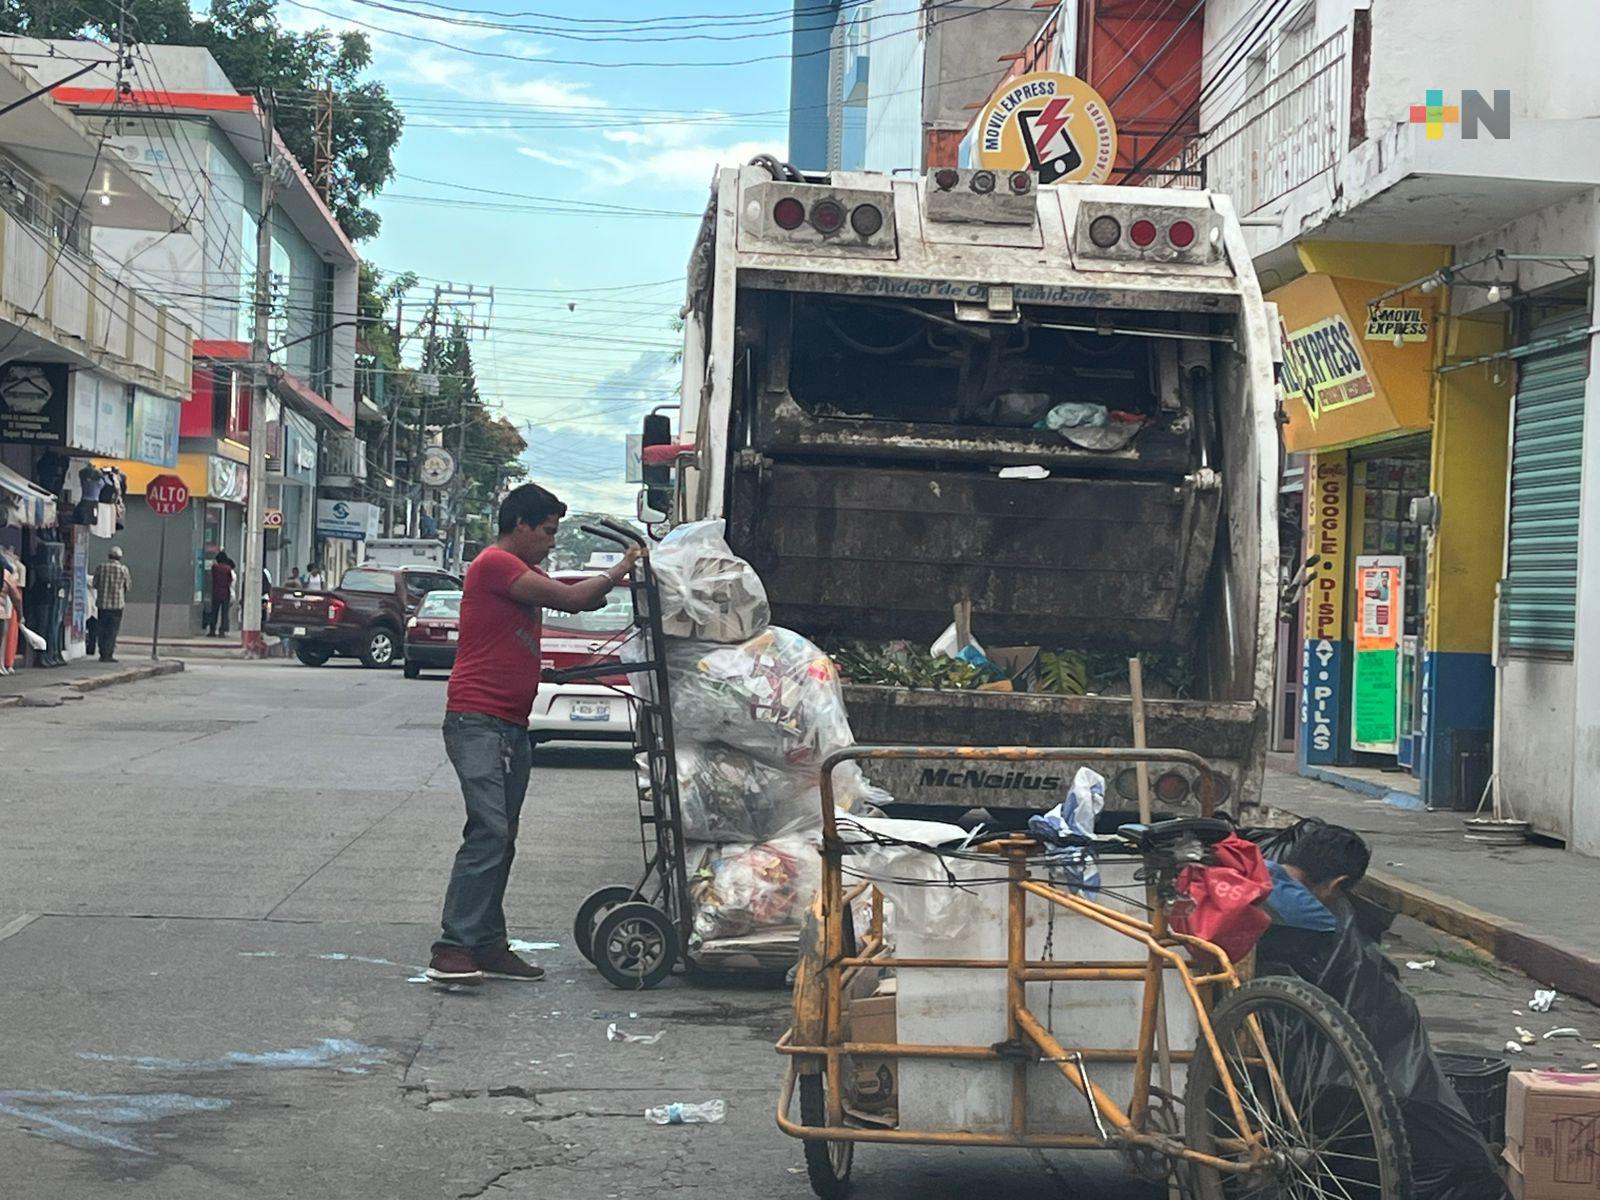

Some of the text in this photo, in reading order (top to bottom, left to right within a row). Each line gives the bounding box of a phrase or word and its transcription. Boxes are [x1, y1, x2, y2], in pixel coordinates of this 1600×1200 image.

[985, 81, 1056, 151] MOVIL EXPRESS
[864, 277, 931, 295] Ciudad
[938, 280, 960, 297] de
[1380, 309, 1420, 322] MOVIL
[1368, 322, 1428, 335] EXPRESS
[1292, 321, 1361, 385] EXPRESS
[149, 486, 186, 502] ALTO
[157, 502, 176, 513] 1X1
[1321, 482, 1340, 554] GOOGLE
[1315, 578, 1336, 667] DISPLAY
[1313, 686, 1333, 751] PILAS
[919, 768, 1062, 791] McNeilus
